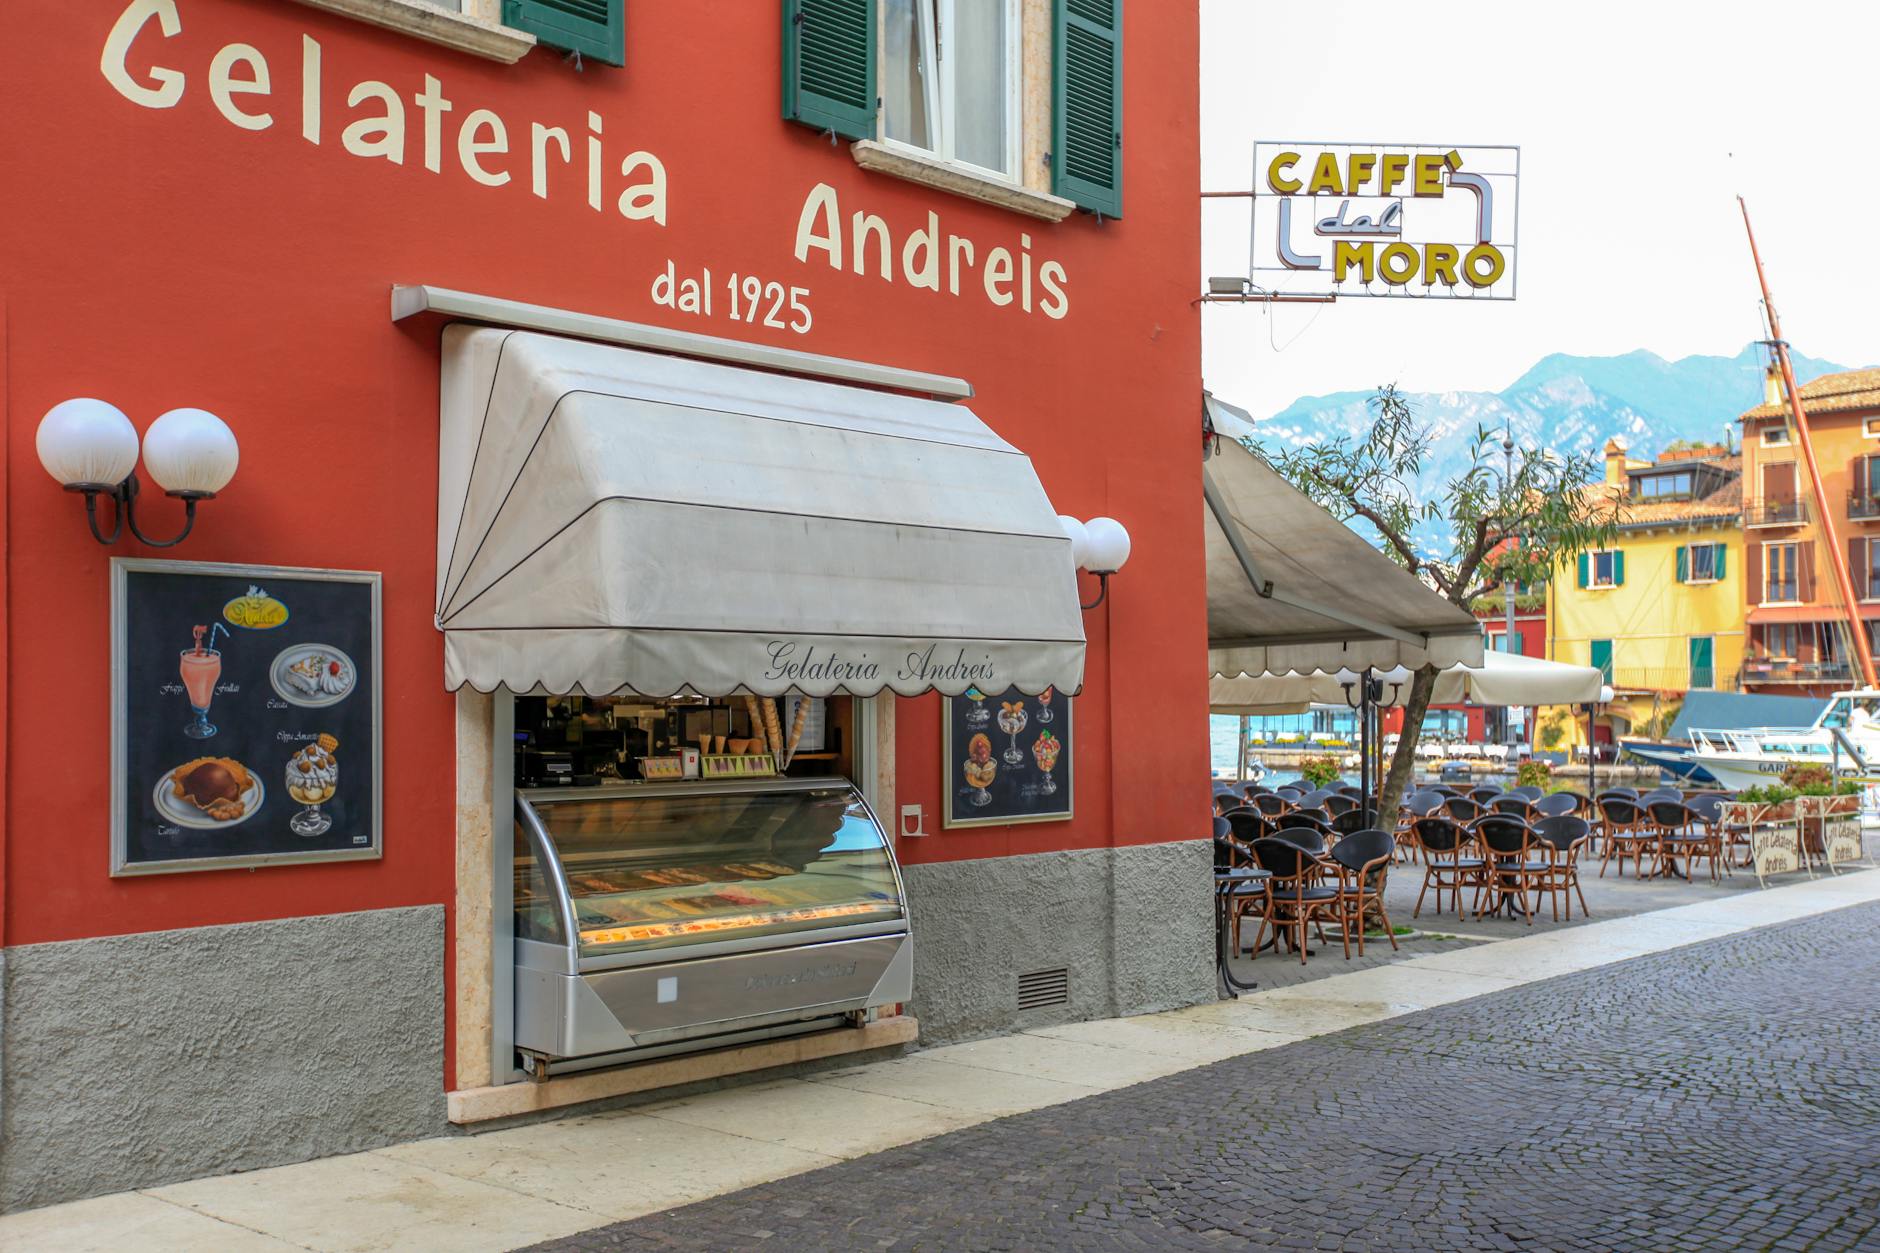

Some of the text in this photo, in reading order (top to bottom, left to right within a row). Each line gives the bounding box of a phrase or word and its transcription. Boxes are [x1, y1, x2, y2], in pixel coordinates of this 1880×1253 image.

[100, 0, 1070, 320] Gelateria Andreis
[1332, 240, 1505, 289] MORO
[651, 259, 813, 335] dal 1925
[764, 641, 995, 680] Gelateria Andreis
